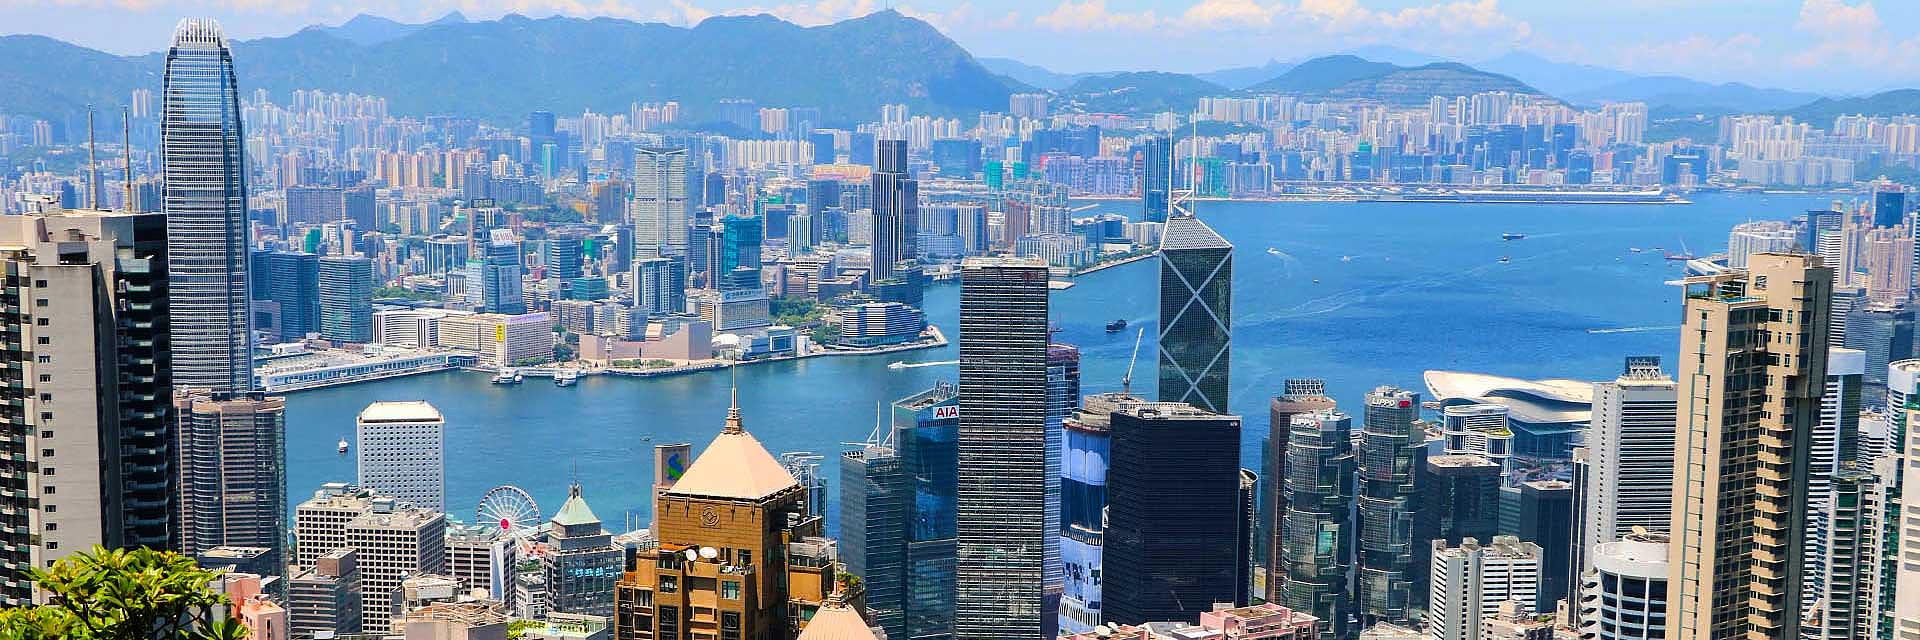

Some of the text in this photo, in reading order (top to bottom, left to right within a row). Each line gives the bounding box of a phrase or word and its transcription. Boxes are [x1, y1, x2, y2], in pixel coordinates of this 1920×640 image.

[1372, 397, 1395, 407] LIPPO
[936, 407, 958, 418] AIA
[1292, 418, 1315, 427] LIPPO
